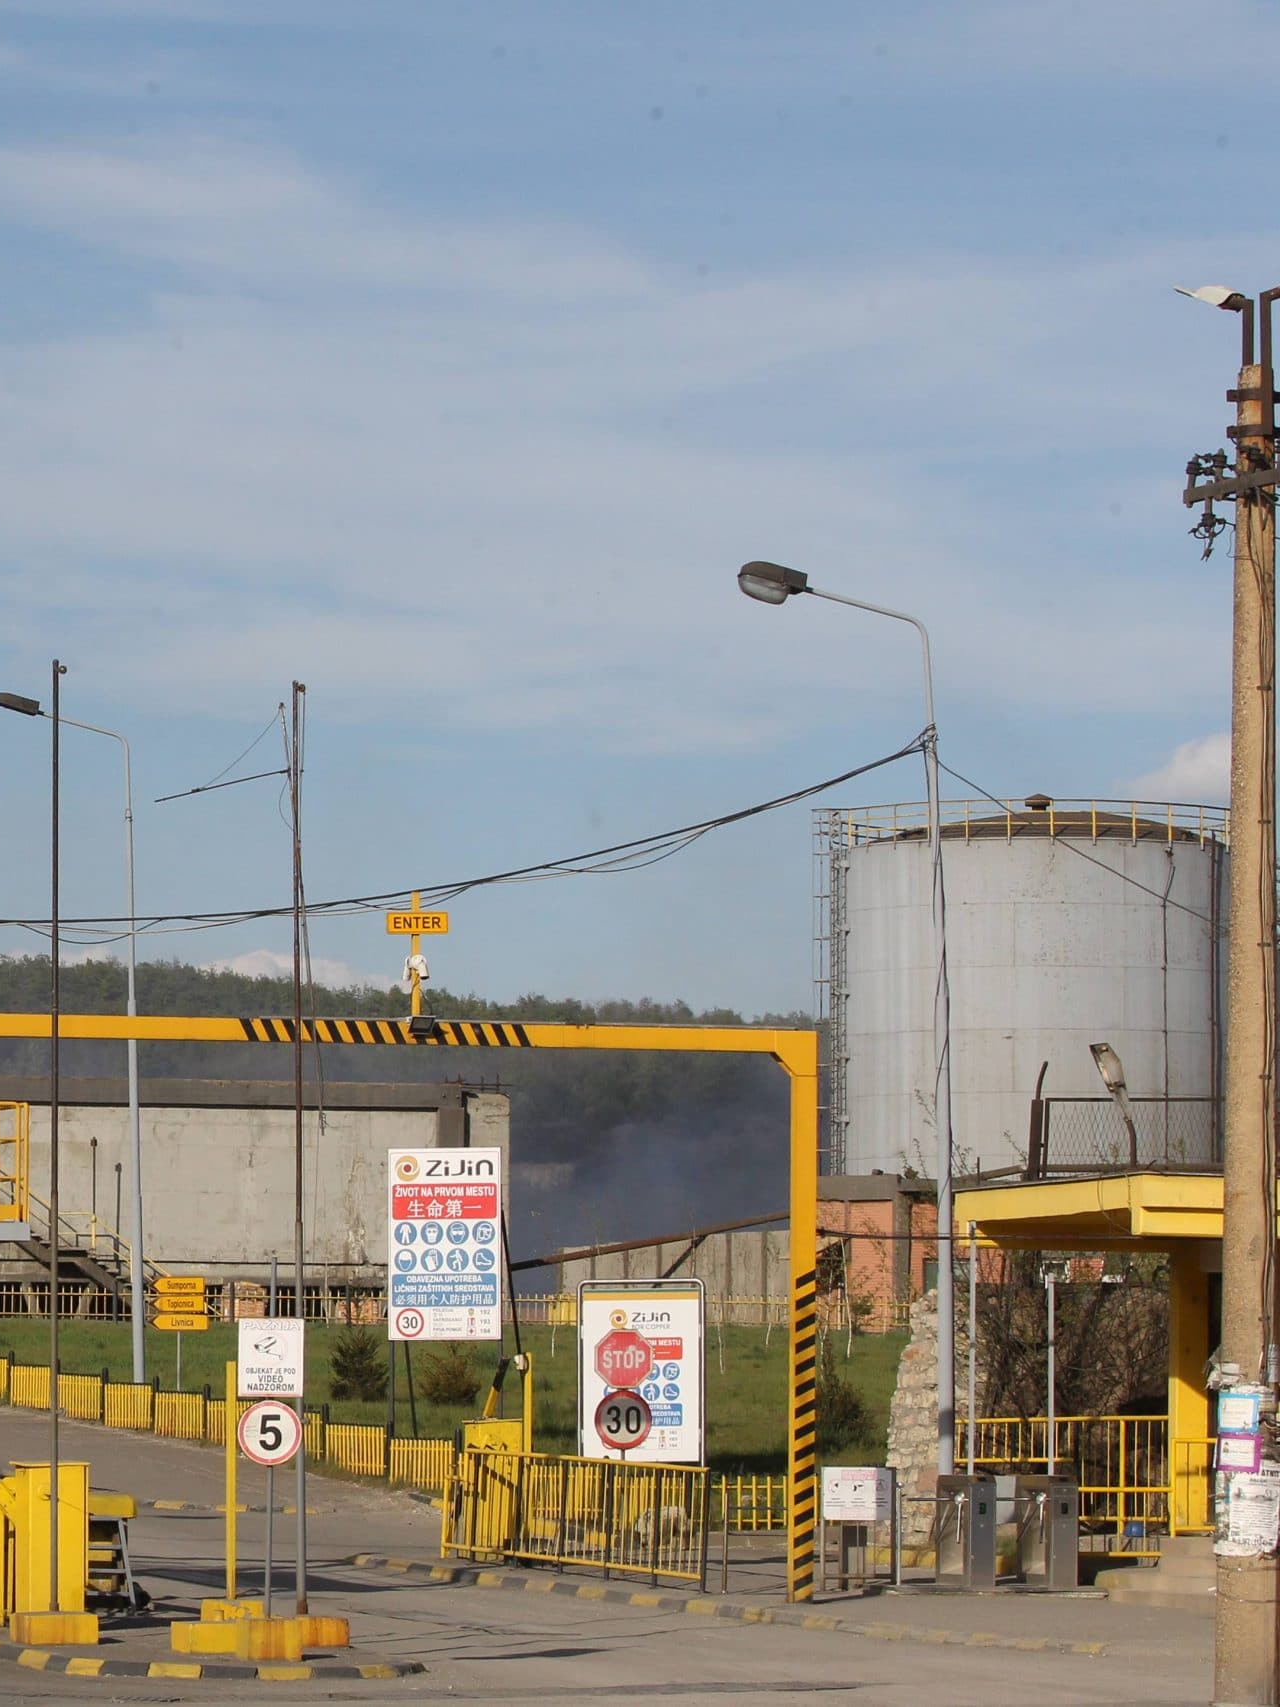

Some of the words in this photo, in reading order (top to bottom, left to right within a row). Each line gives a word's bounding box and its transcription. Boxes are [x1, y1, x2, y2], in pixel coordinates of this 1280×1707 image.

[393, 917, 441, 928] ENTER
[395, 1186, 419, 1197] ŽIVOT
[421, 1187, 433, 1196] NA
[434, 1187, 464, 1196] PRVOM
[466, 1186, 494, 1196] MESTU
[407, 1199, 481, 1217] 生命第一
[394, 1284, 416, 1292] LIČNIH
[418, 1284, 453, 1292] ZAŠTITNIH
[395, 1294, 493, 1305] 必须用个人防护用品
[171, 1318, 194, 1326] Livnica
[402, 1316, 418, 1329] 30
[603, 1350, 645, 1369] STOP
[258, 1375, 283, 1383] VIDEO
[247, 1383, 294, 1391] NADZOROM
[607, 1406, 641, 1434] 30
[259, 1414, 282, 1451] 5
